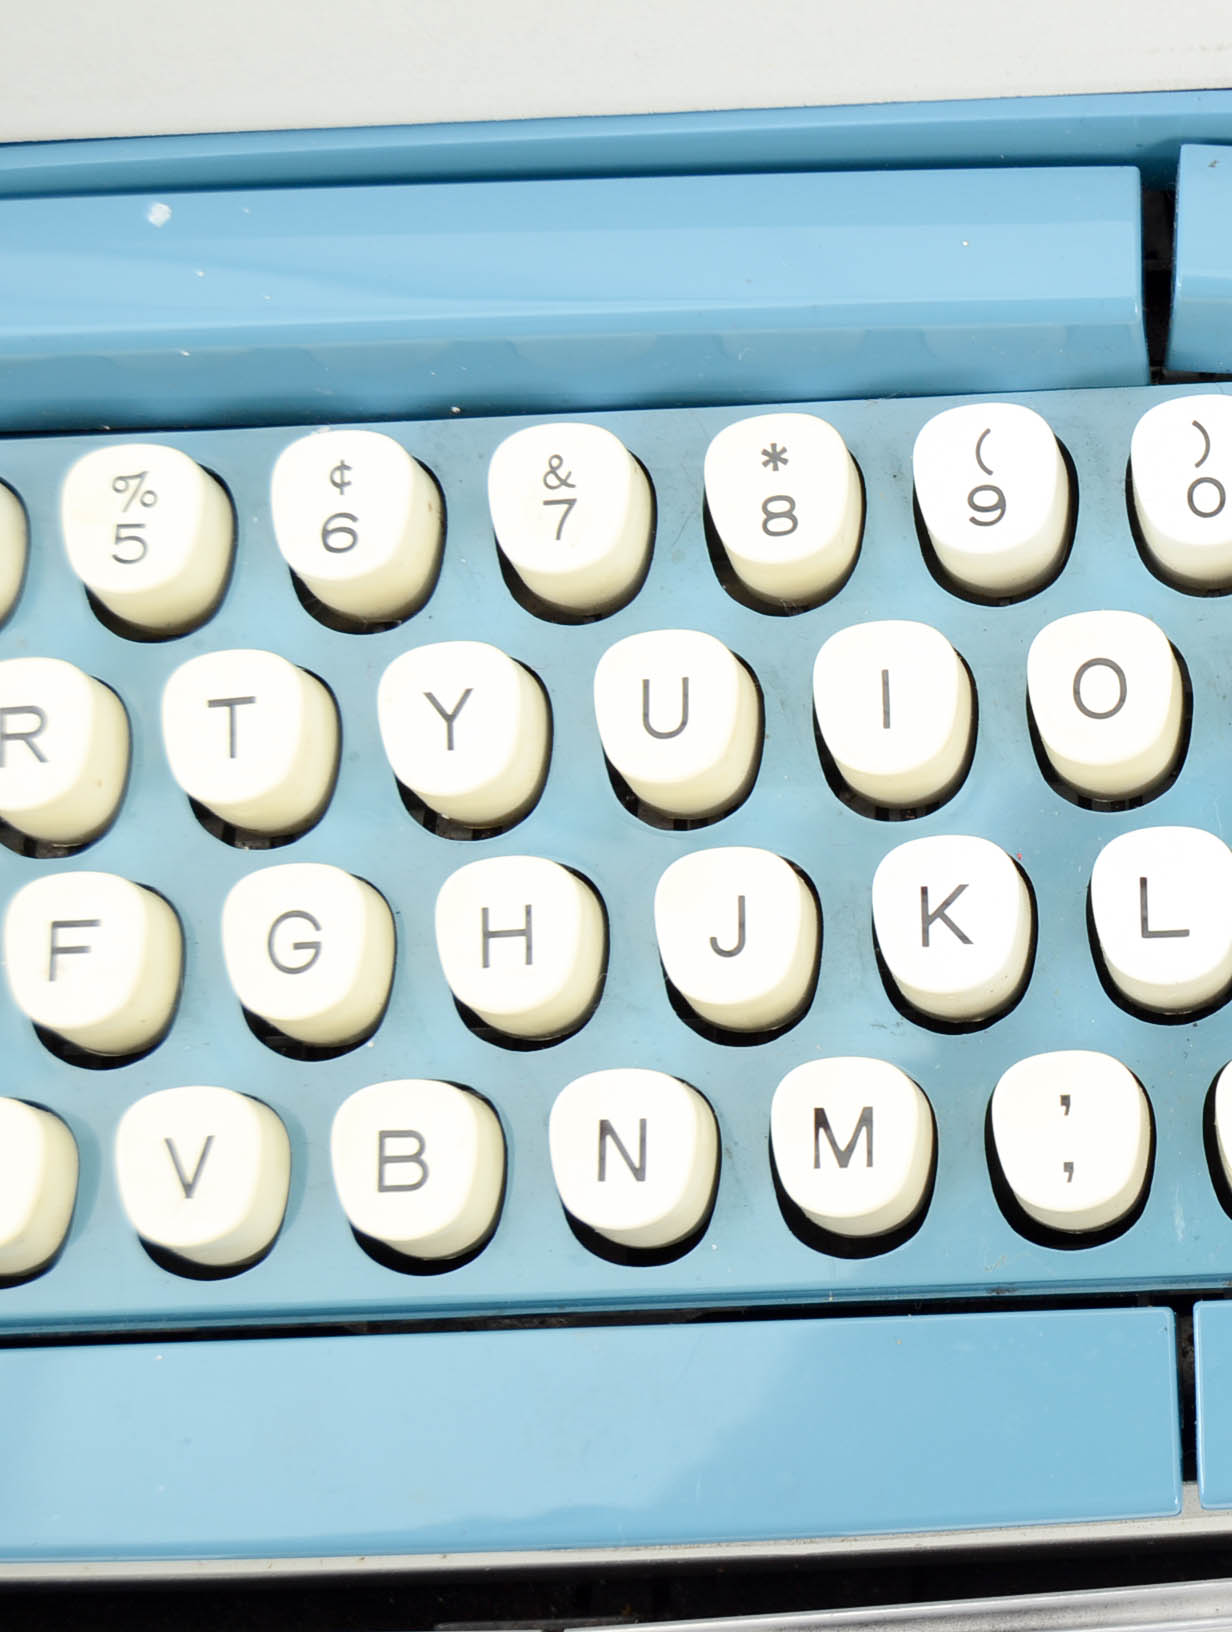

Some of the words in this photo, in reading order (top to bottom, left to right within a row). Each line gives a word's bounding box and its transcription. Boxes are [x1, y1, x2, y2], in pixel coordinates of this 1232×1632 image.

[542, 453, 577, 491] &
[975, 428, 994, 476] (
[1191, 419, 1211, 469] )
[111, 470, 158, 513] %
[329, 459, 353, 496] ¢
[967, 484, 1007, 527] 9
[111, 523, 147, 565] 5
[320, 511, 359, 554] 6
[541, 497, 578, 541] 7
[761, 494, 799, 537] 8
[423, 687, 473, 752] Y
[641, 676, 690, 740] U
[880, 668, 891, 730] I
[1072, 657, 1128, 720] O
[0, 704, 48, 768] R
[206, 695, 256, 759] T
[480, 903, 533, 969] H
[709, 894, 746, 959] J
[919, 883, 974, 948] K
[1139, 876, 1190, 939] L
[47, 918, 100, 982] F
[266, 909, 322, 975] G
[163, 1135, 215, 1200] V
[376, 1129, 429, 1194] B
[597, 1117, 647, 1182] N
[813, 1106, 874, 1169] M
